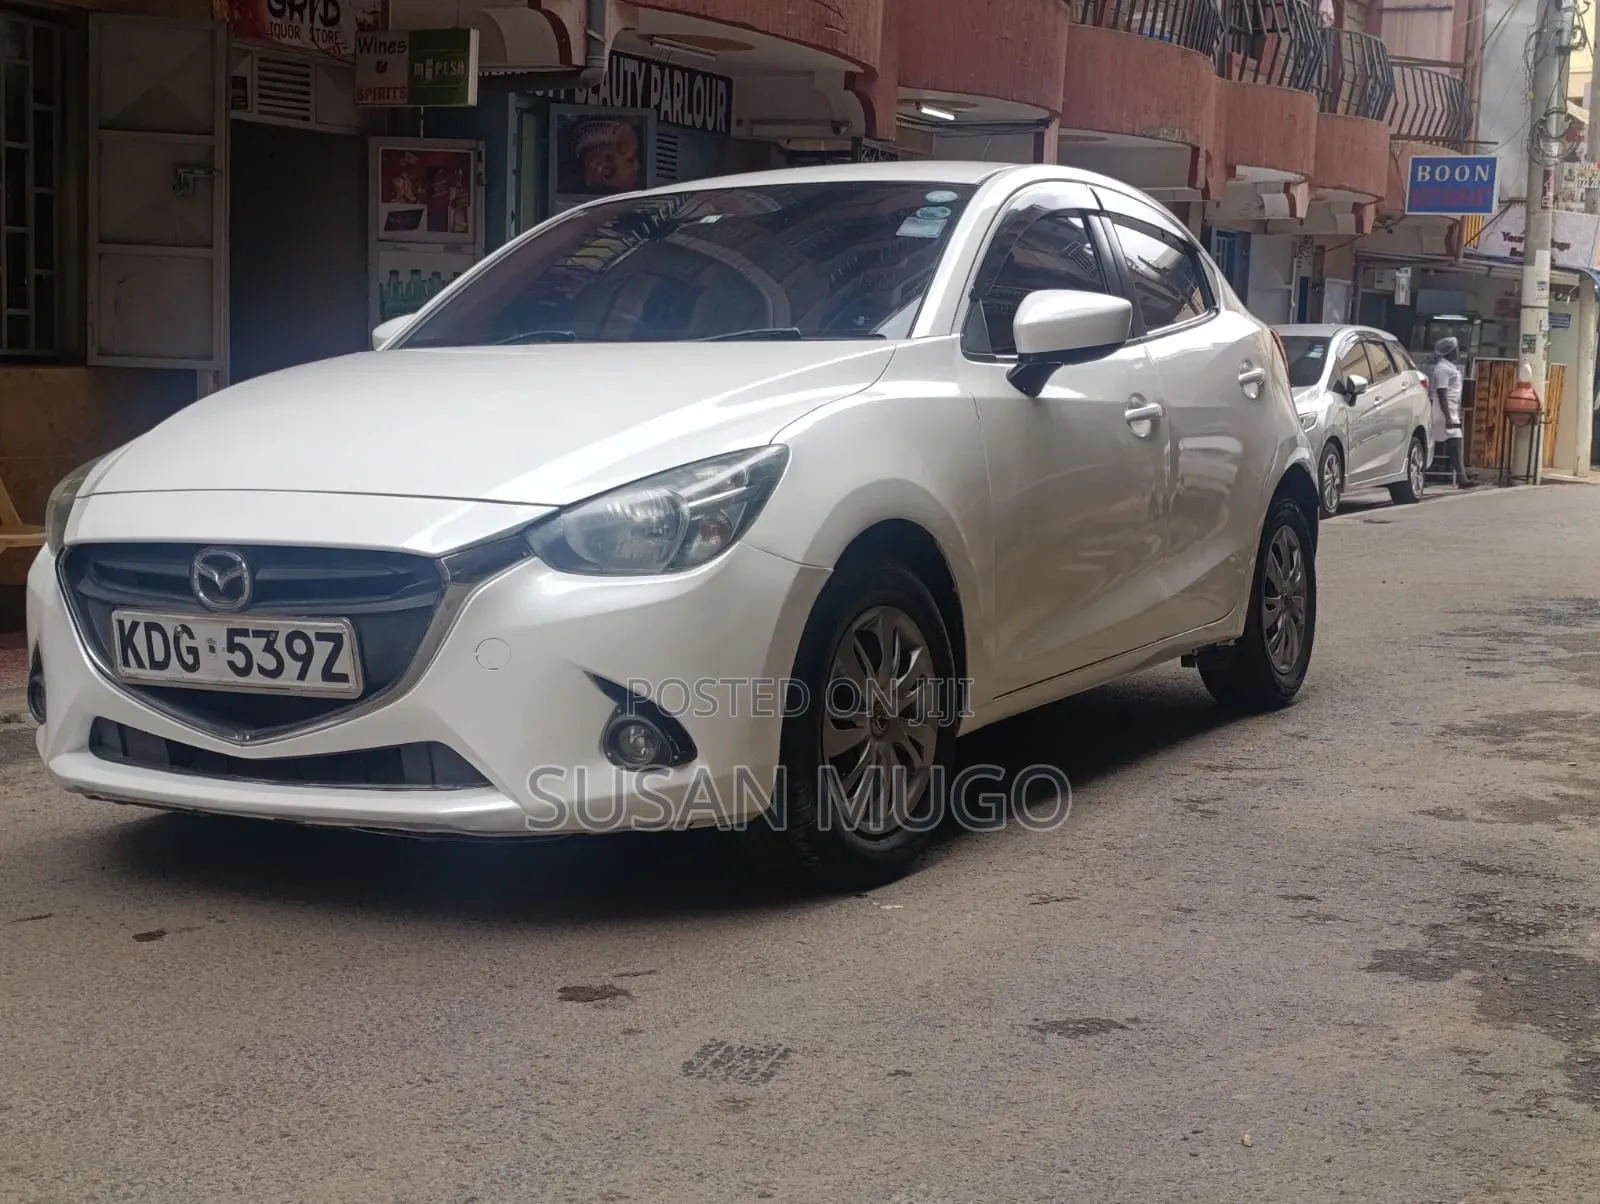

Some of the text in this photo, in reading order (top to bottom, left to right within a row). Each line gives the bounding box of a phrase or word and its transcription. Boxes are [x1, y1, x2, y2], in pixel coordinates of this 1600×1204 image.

[264, 21, 341, 45] LIQUOR STORE
[358, 35, 407, 55] Wines
[357, 86, 407, 102] SPIRITS
[574, 55, 727, 133] AUTY PARLOUR
[1416, 164, 1491, 183] BOON
[116, 619, 350, 684] KDG 539Z
